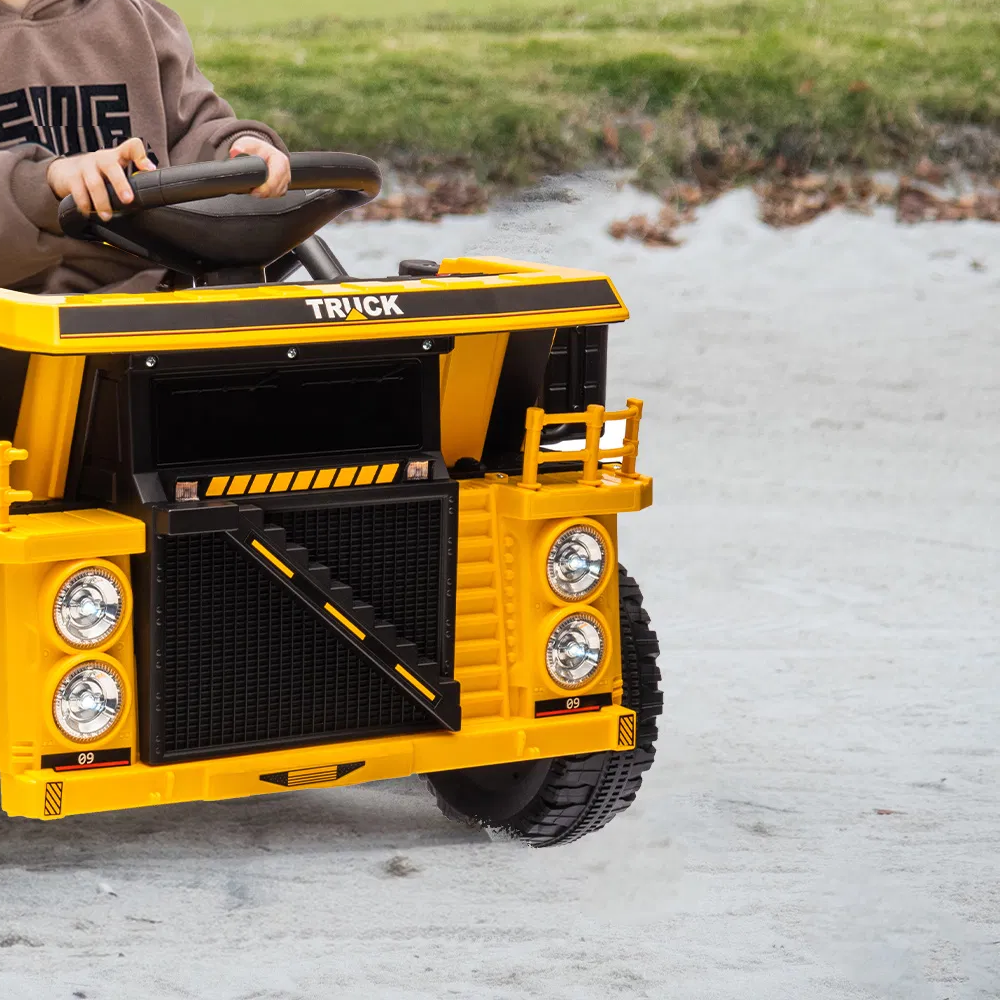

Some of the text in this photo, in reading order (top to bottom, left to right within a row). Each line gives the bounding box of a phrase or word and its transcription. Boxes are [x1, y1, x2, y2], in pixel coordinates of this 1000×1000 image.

[304, 294, 405, 320] TRUCK
[566, 697, 580, 709] 09
[77, 752, 95, 765] 09
